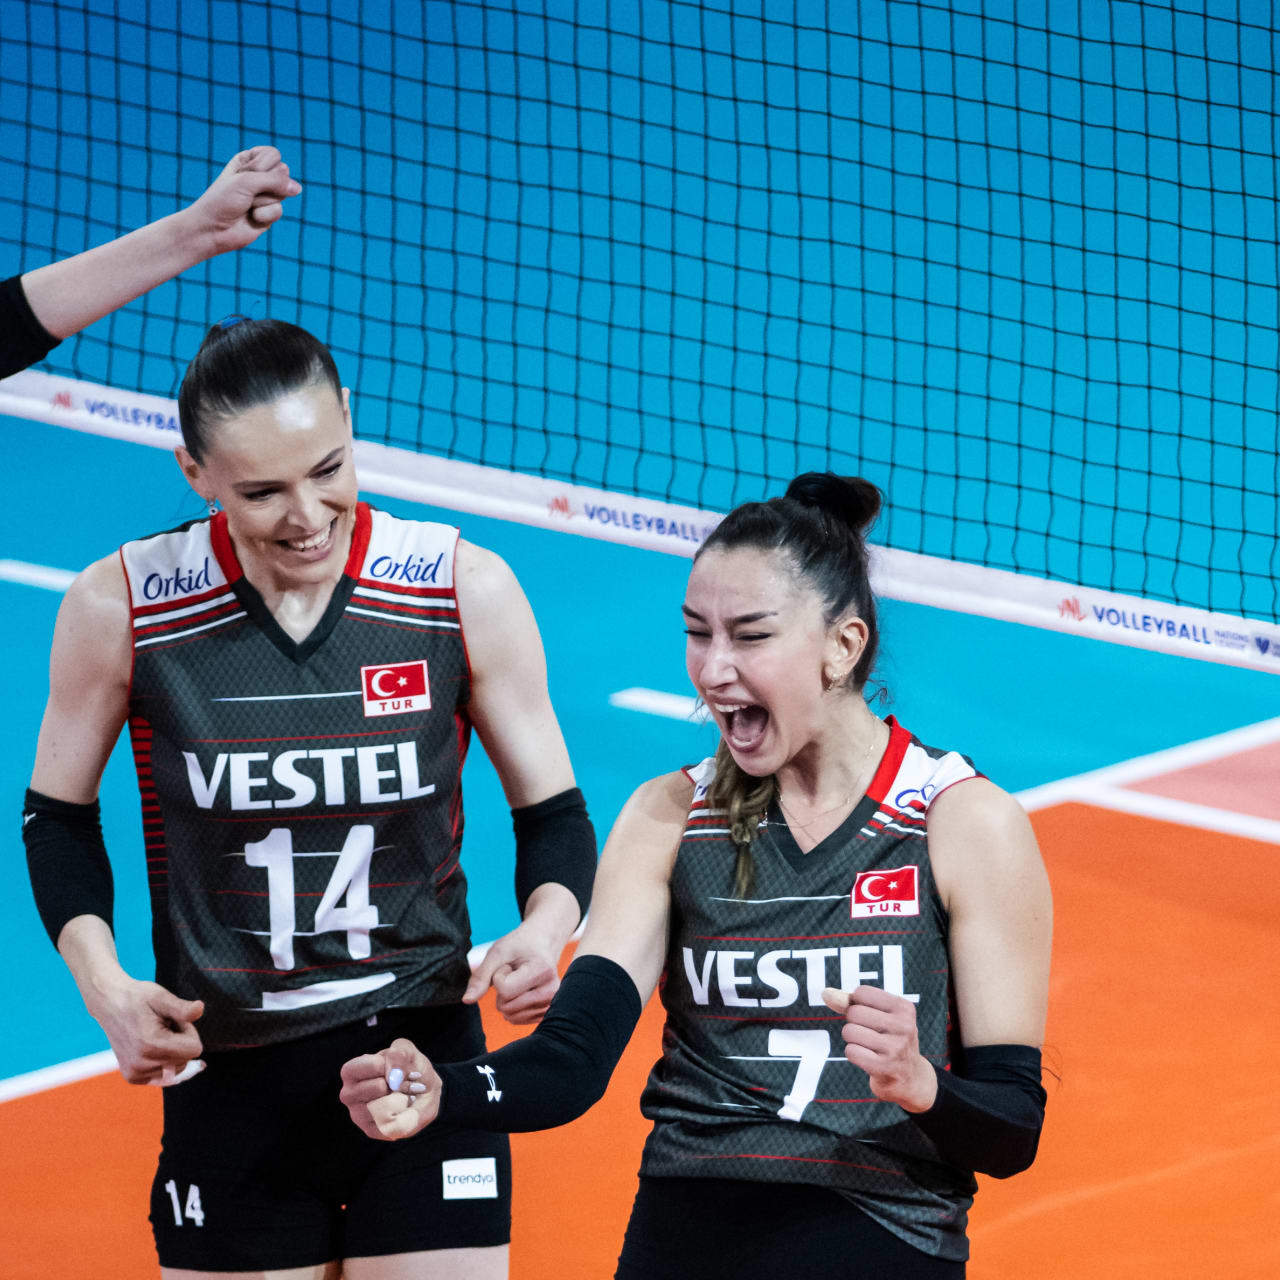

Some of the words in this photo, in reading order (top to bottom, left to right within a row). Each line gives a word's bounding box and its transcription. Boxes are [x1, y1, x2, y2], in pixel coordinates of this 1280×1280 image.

[584, 503, 700, 543] VOLLEYBALL
[142, 557, 213, 601] Orkid
[368, 552, 446, 584] Orkid
[1092, 604, 1211, 645] VOLLEYBALL
[378, 699, 414, 713] TUR
[181, 740, 436, 811] VESTEL
[244, 824, 380, 971] 14
[866, 902, 902, 914] TUR
[682, 944, 920, 1008] VESTEL
[768, 1028, 831, 1122] 7
[165, 1179, 205, 1227] 14
